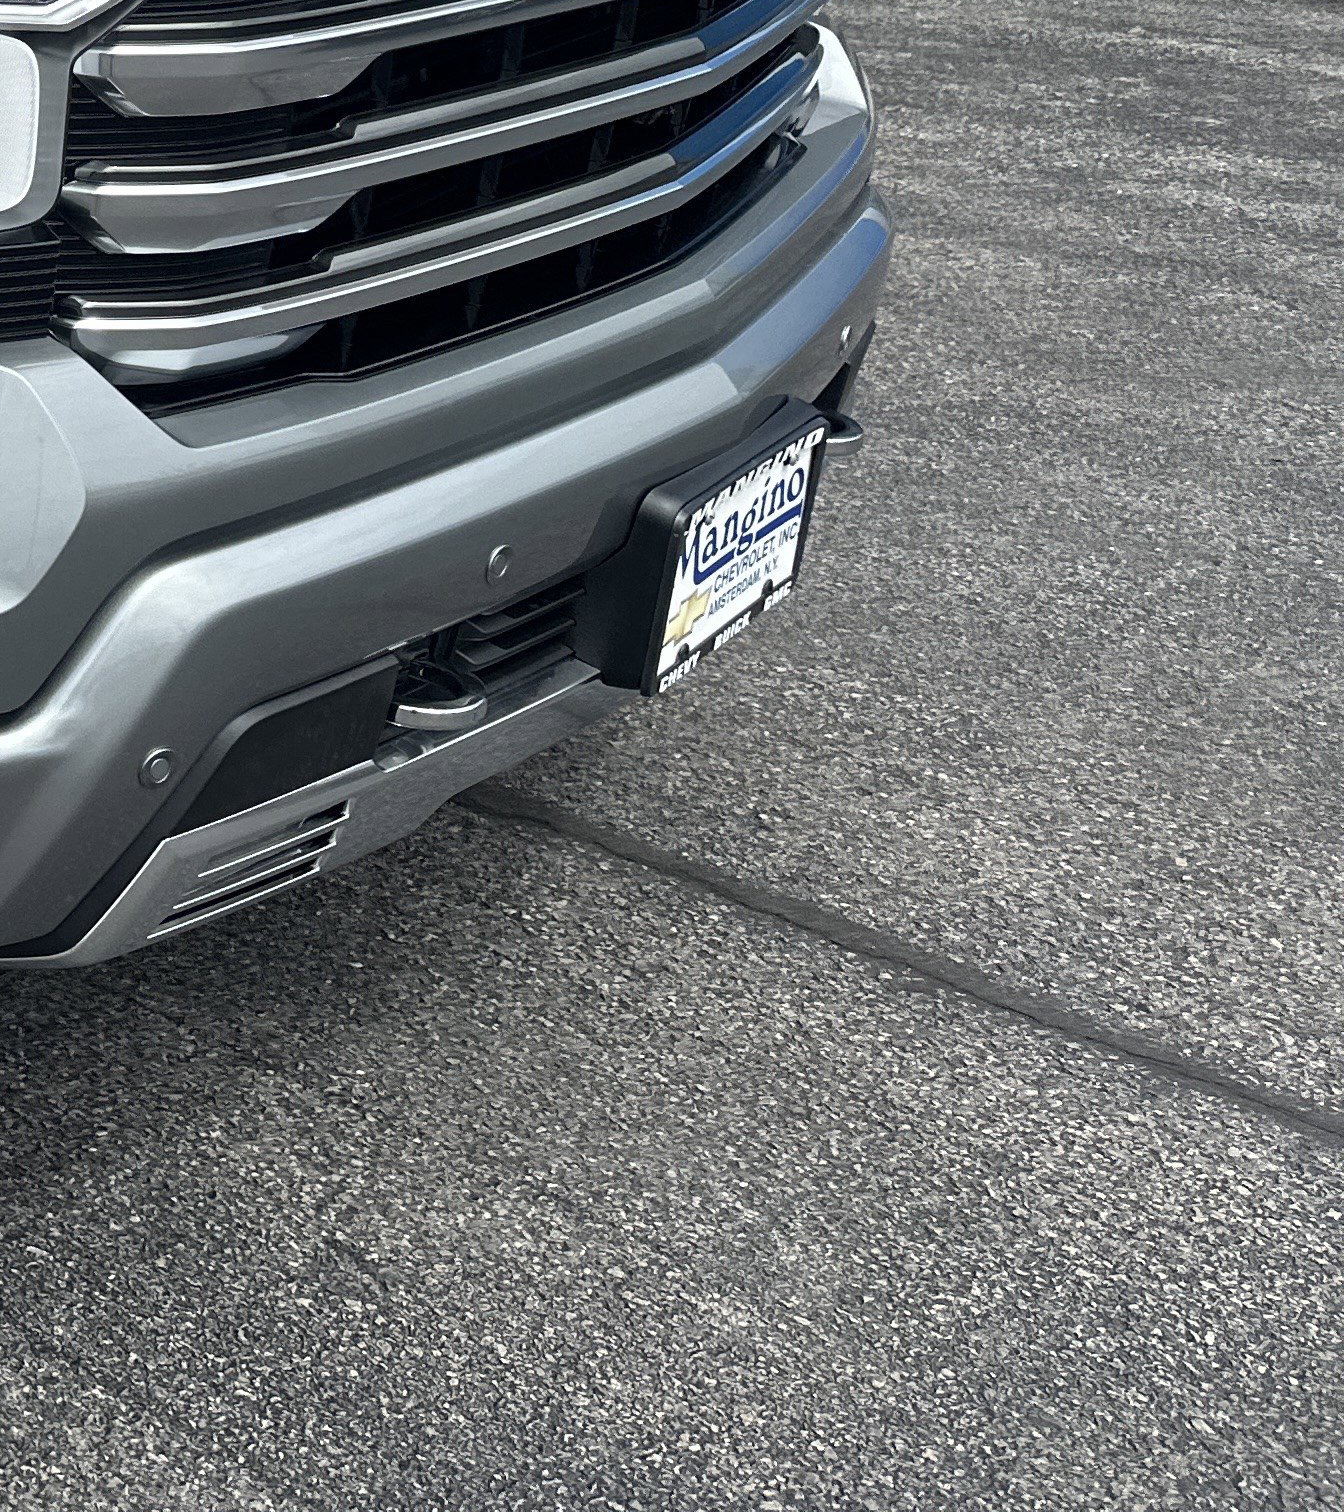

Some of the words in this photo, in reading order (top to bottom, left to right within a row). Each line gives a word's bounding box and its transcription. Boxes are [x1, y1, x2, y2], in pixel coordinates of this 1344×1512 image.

[678, 466, 805, 585] Mangino
[658, 650, 702, 694] CHEVY
[713, 610, 752, 651] BUICK
[763, 580, 794, 612] GMC
